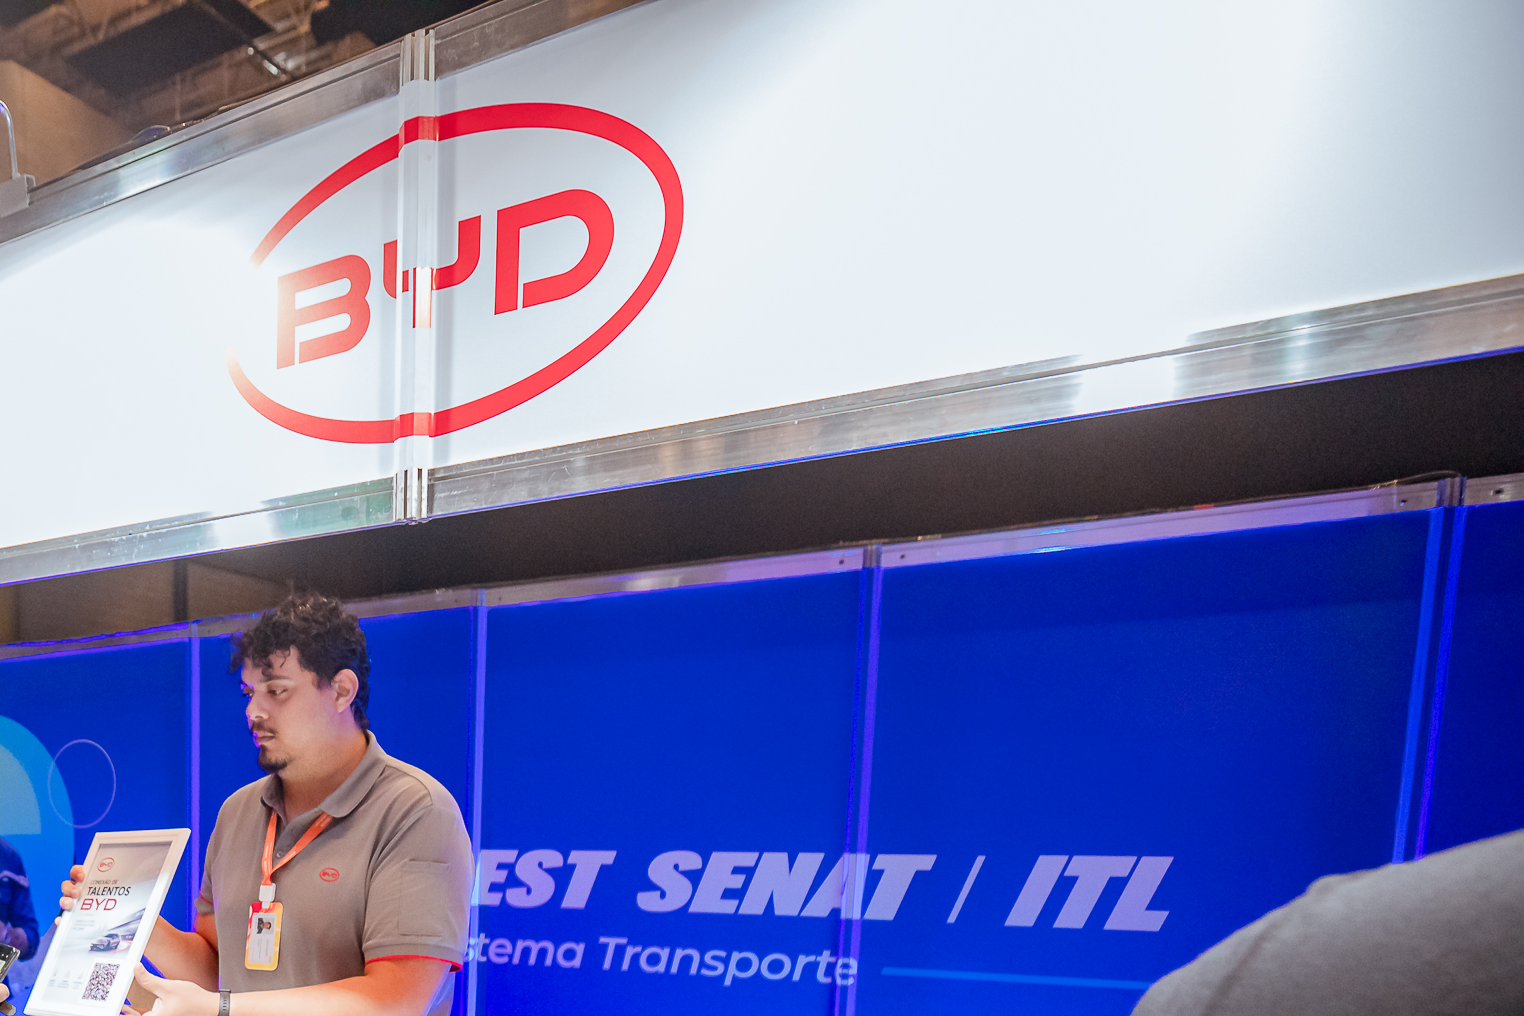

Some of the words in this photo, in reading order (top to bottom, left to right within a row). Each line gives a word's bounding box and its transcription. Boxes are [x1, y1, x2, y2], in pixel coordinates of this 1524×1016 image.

[276, 188, 615, 370] BYD
[80, 898, 117, 910] BYD
[87, 886, 131, 896] TALENTOS
[470, 849, 617, 909] EST
[636, 849, 937, 921] SENAT
[1004, 855, 1175, 931] ITL
[463, 933, 585, 969] stema
[599, 936, 859, 986] Transporte
